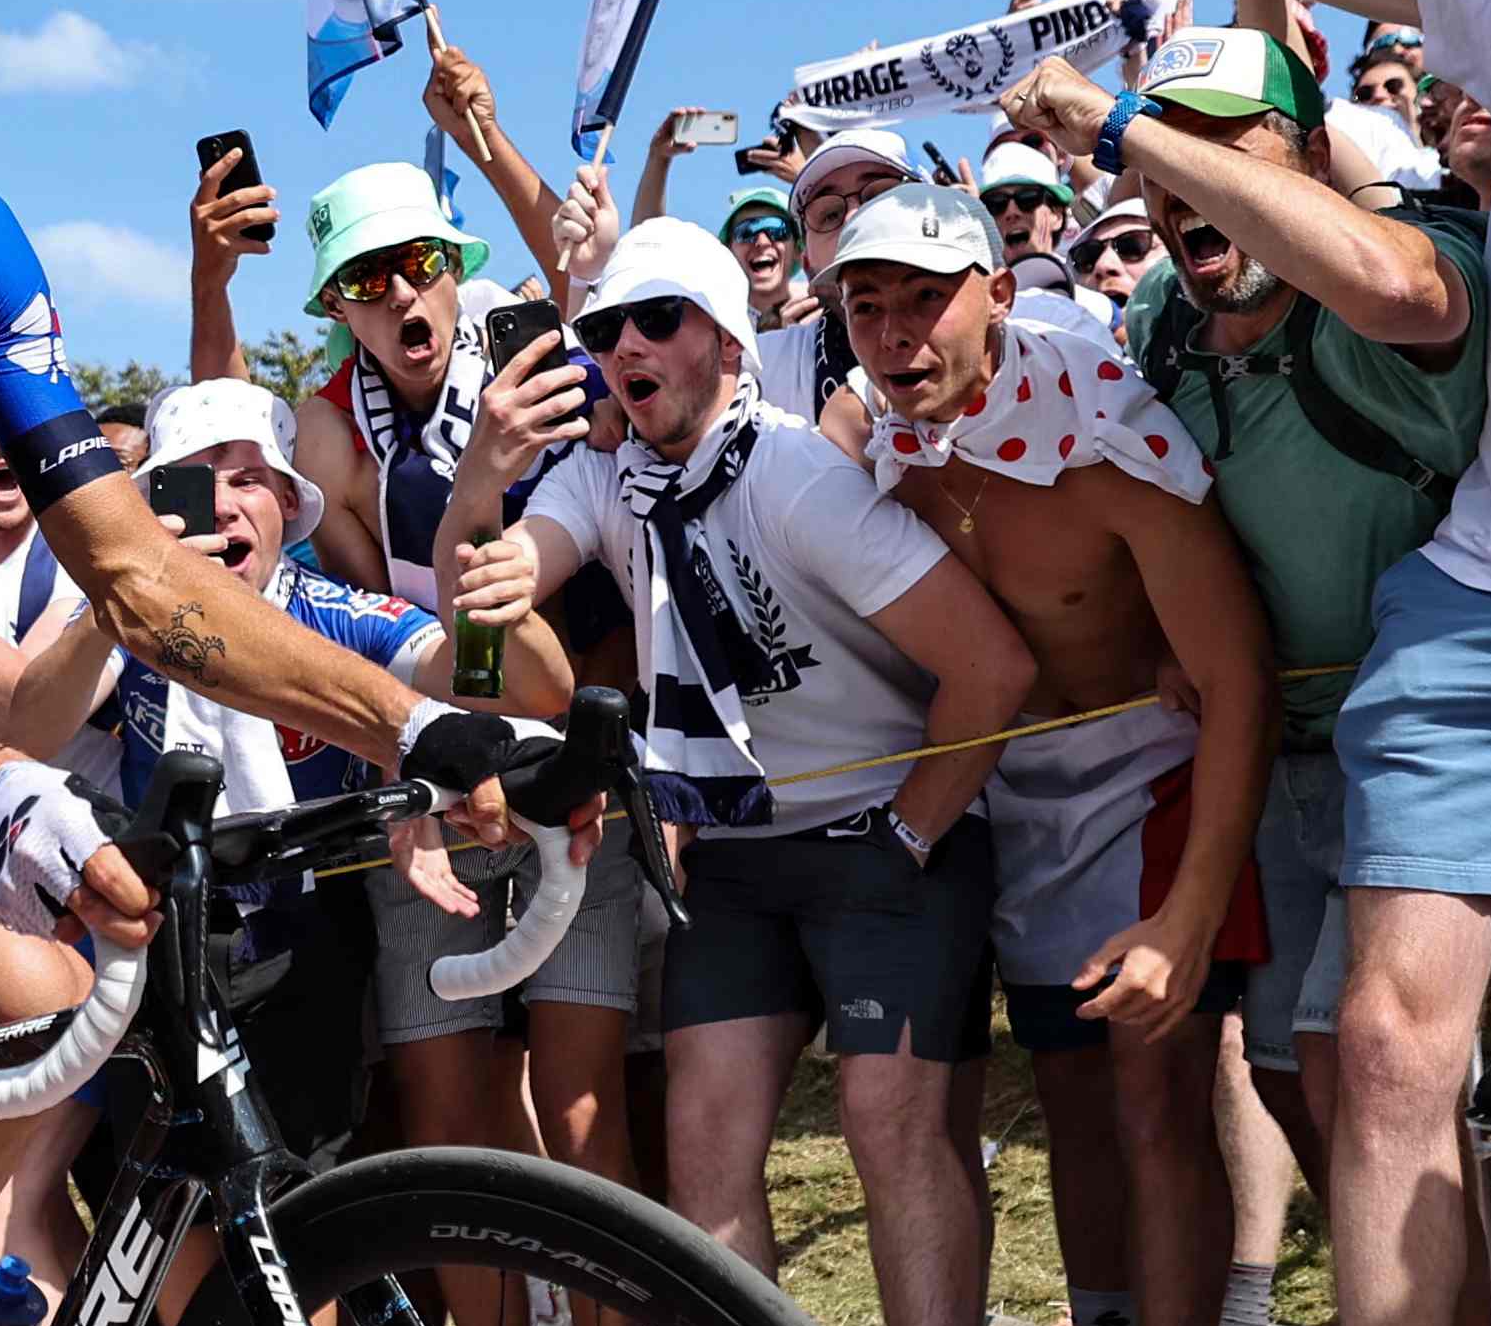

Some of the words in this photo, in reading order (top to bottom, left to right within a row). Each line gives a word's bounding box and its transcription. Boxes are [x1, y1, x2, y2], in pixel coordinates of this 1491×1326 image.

[803, 57, 908, 109] VIRAGE
[378, 792, 408, 805] GARMIN
[428, 1223, 655, 1303] DURA-ACE
